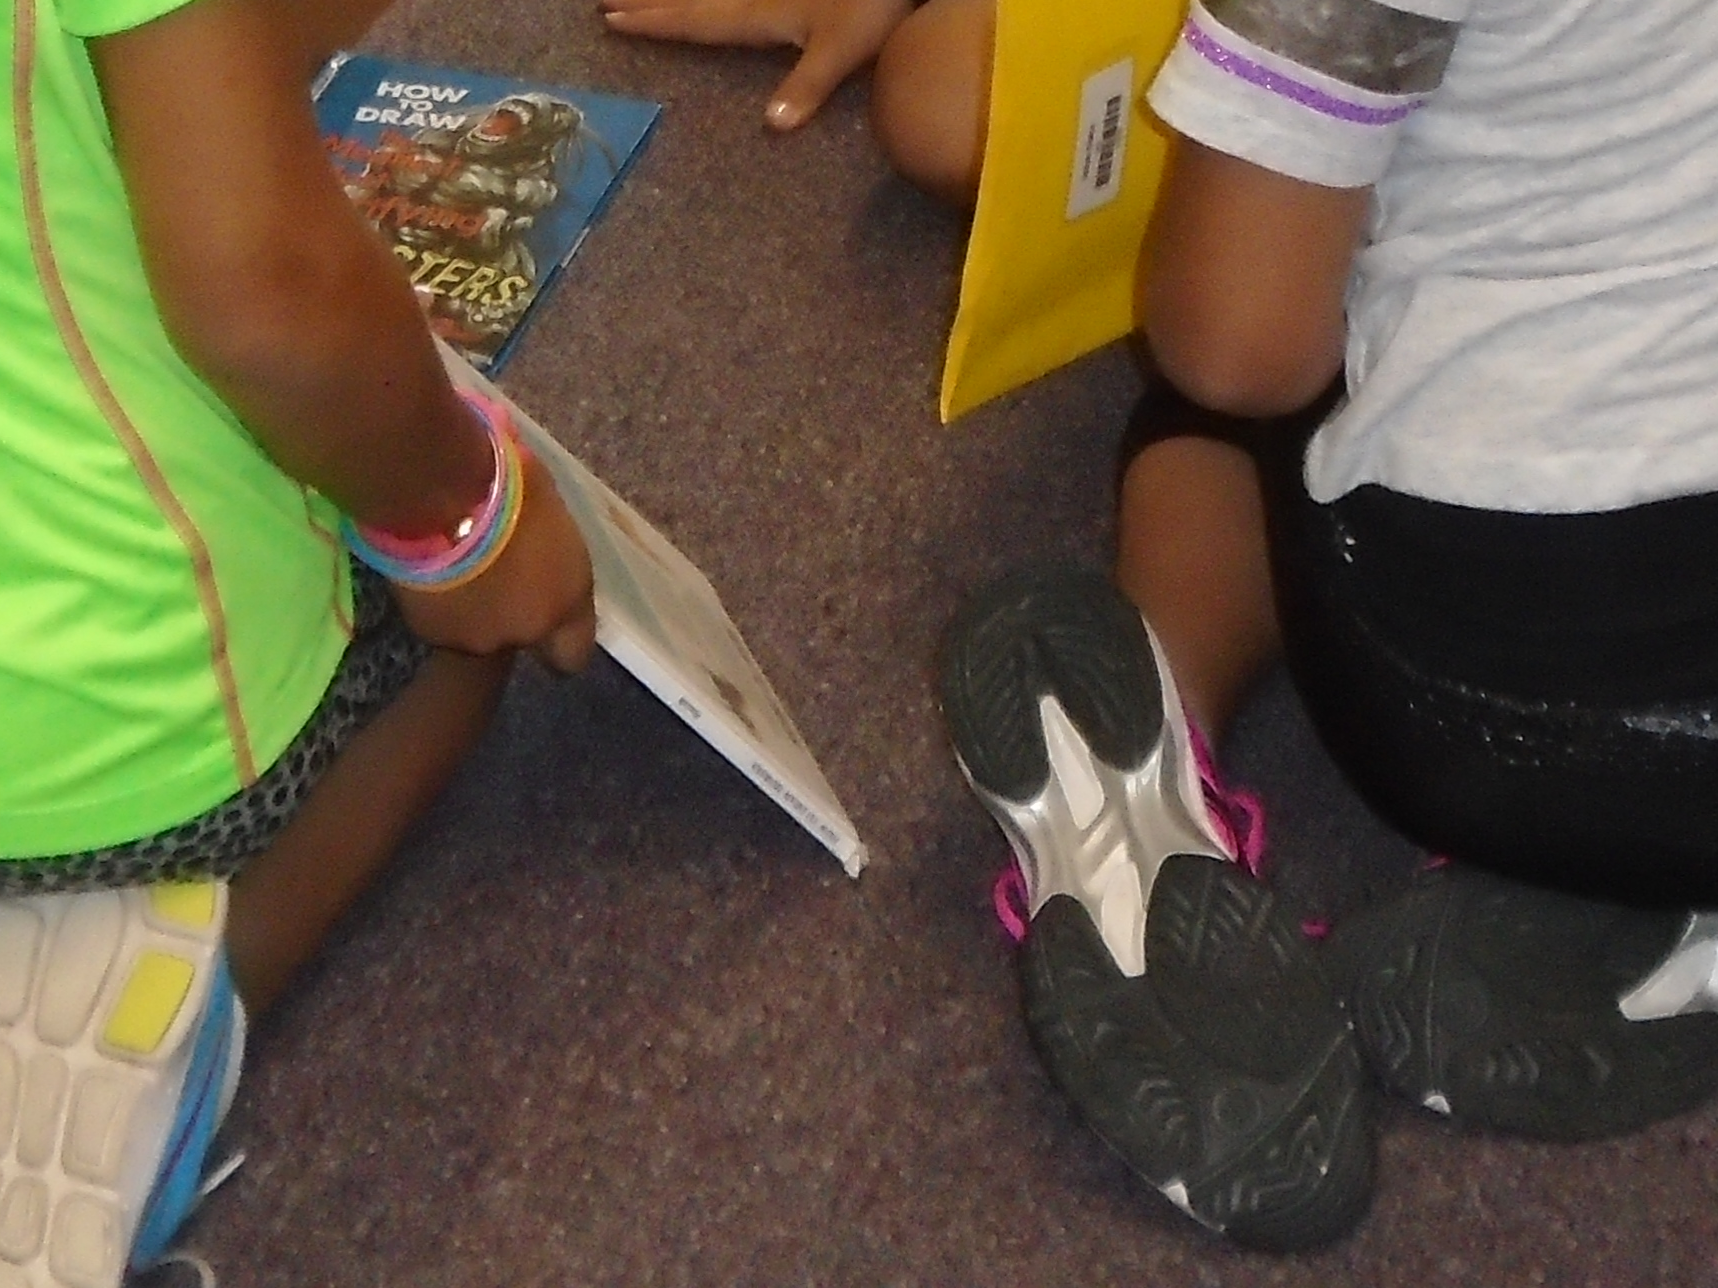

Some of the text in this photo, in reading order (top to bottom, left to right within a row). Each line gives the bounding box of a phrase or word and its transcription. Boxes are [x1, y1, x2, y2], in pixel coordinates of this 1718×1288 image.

[375, 80, 471, 105] HOW
[399, 98, 435, 113] TO
[353, 106, 467, 133] DRAW
